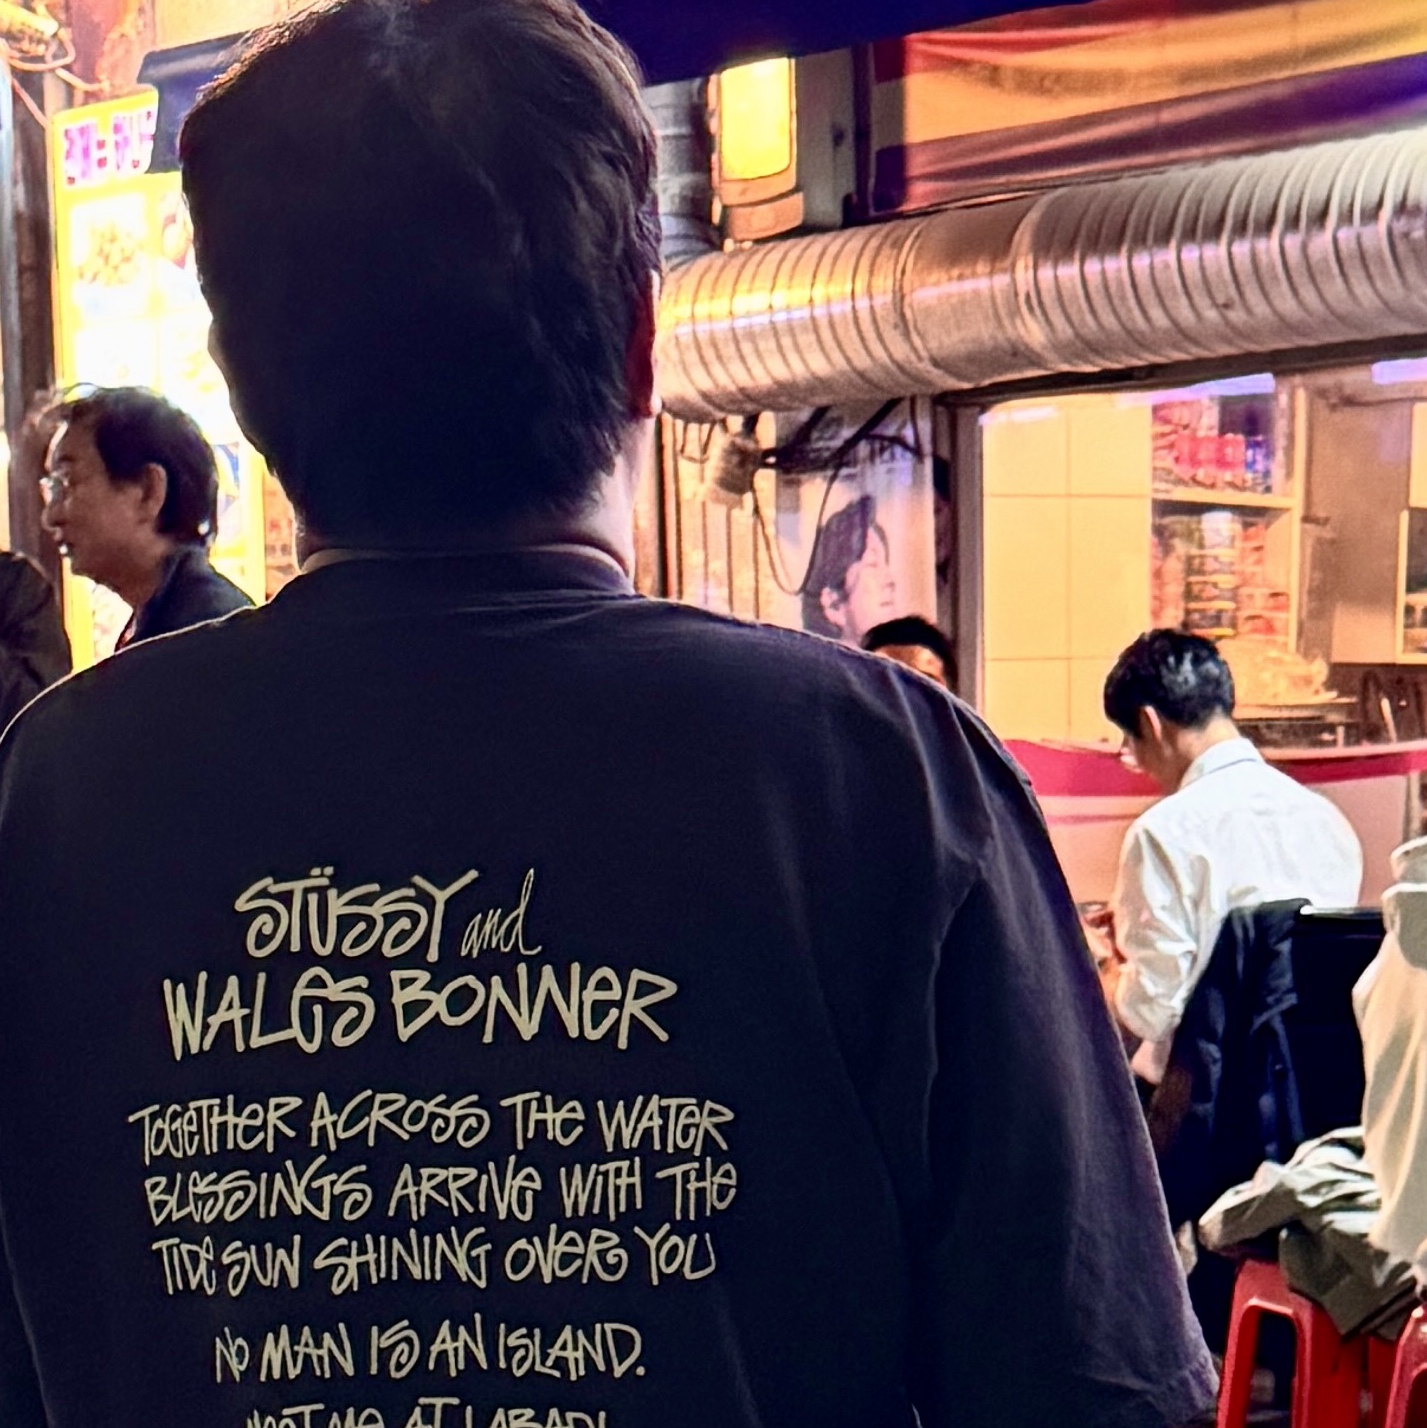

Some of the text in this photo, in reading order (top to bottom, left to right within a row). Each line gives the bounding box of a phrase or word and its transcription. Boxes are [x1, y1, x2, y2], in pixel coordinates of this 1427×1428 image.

[235, 867, 542, 962] STÜSSY and
[164, 962, 677, 1060] WALES BONNER
[128, 1089, 734, 1166] TOGETHER ACROSS THE WATER
[145, 1155, 736, 1226] BLESSINGS ARRIVE WITH THE
[152, 1223, 715, 1296] TIDE SUN SHINING OVER YOU
[216, 1313, 645, 1382] NO MAN IS AN ISLAND.
